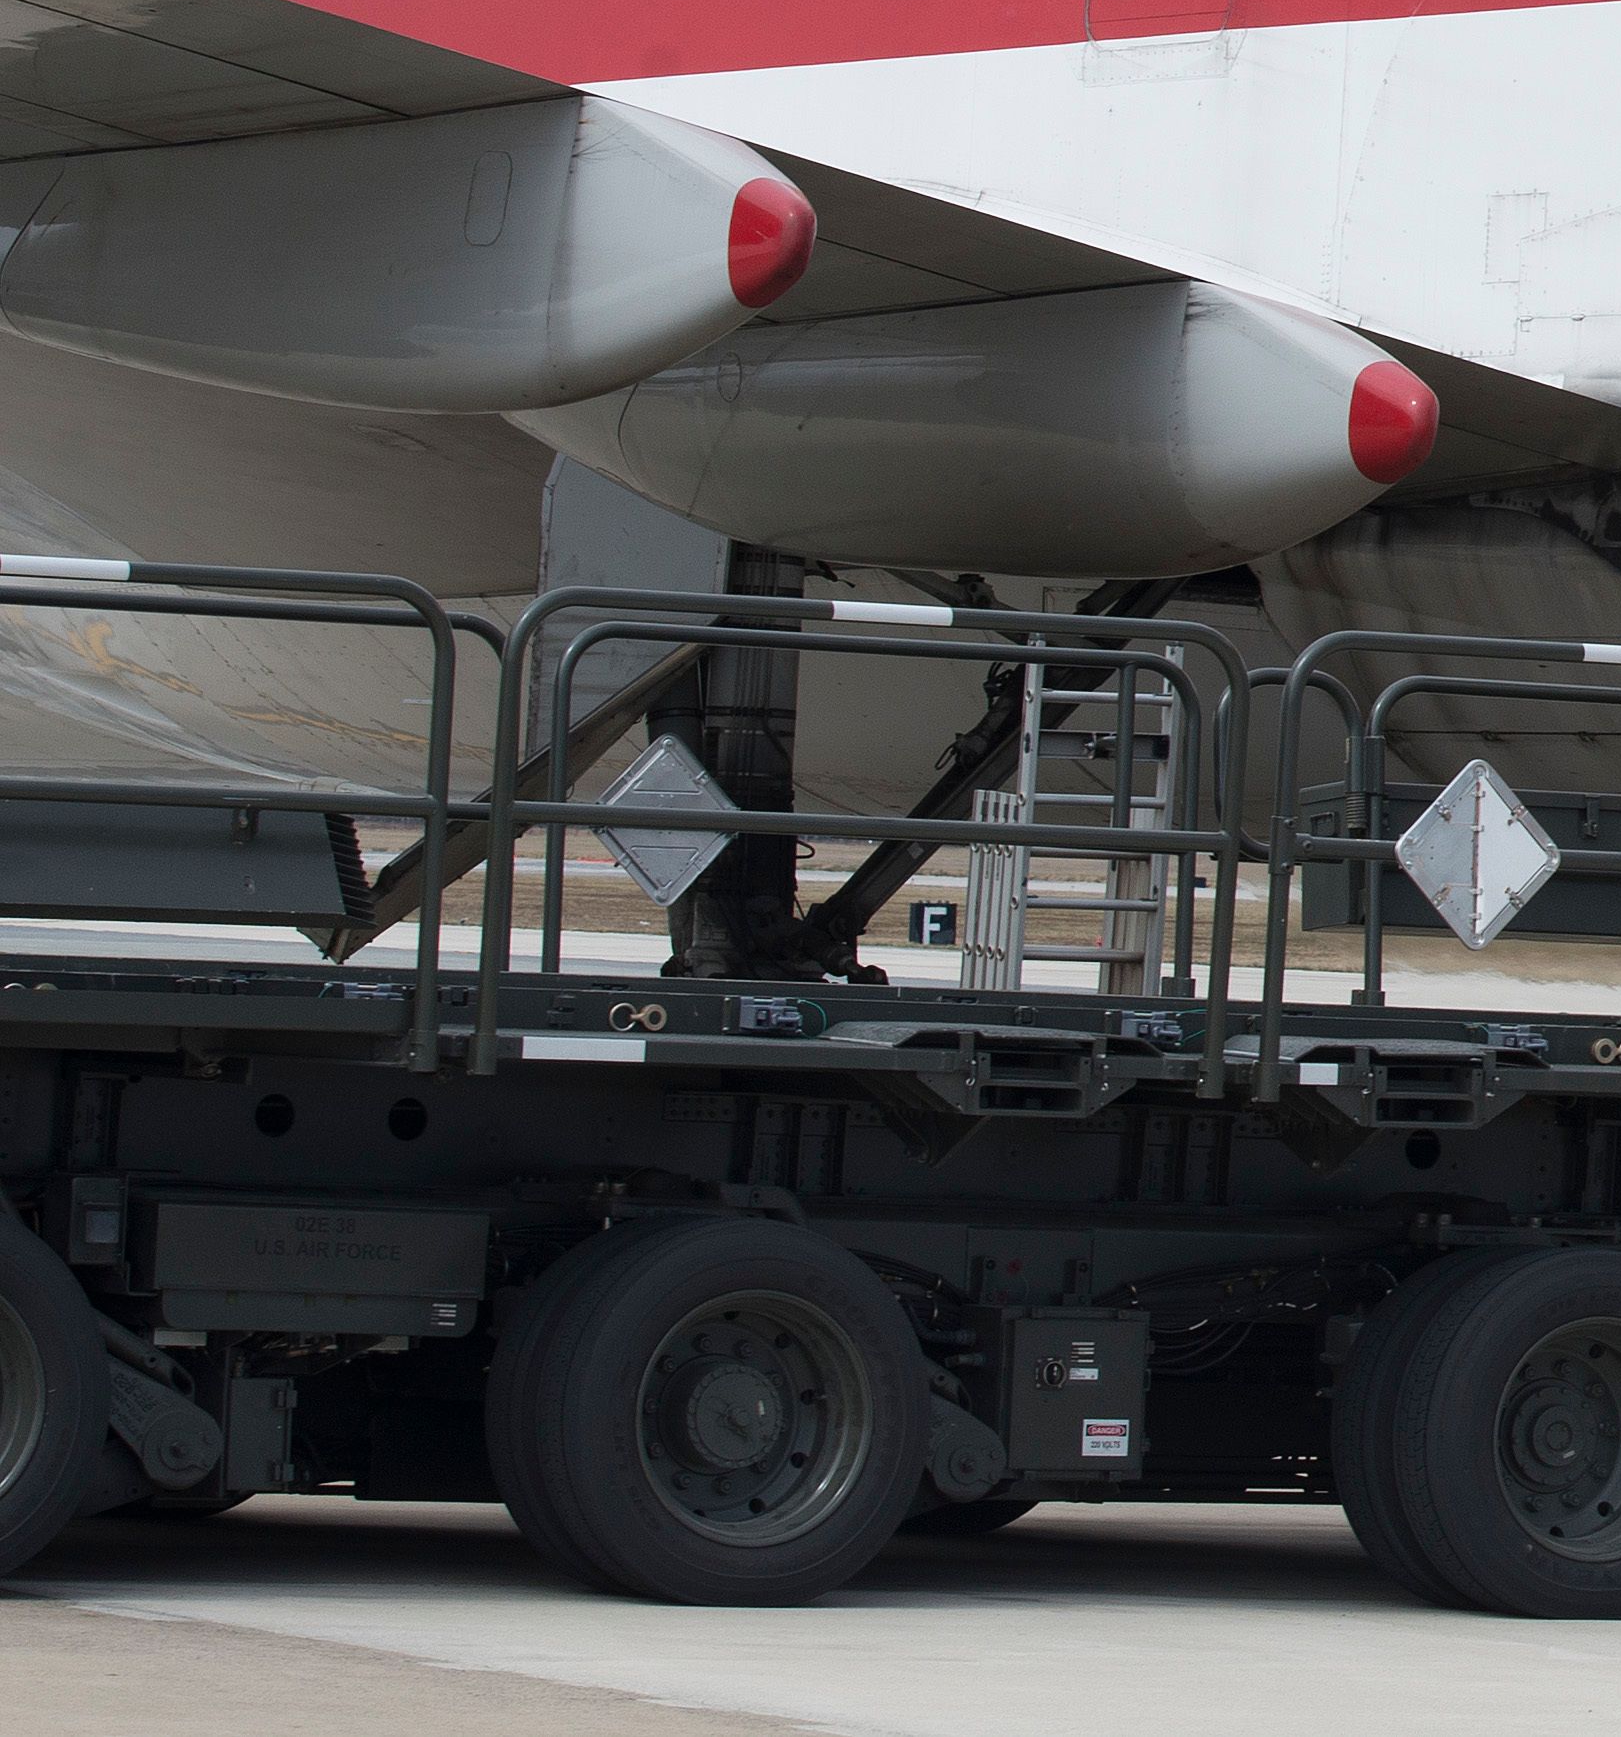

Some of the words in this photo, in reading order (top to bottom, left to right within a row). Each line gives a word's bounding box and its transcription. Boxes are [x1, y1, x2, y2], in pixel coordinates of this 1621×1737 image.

[922, 906, 947, 945] F
[295, 1240, 330, 1259] AIR
[334, 1242, 402, 1262] FORCE
